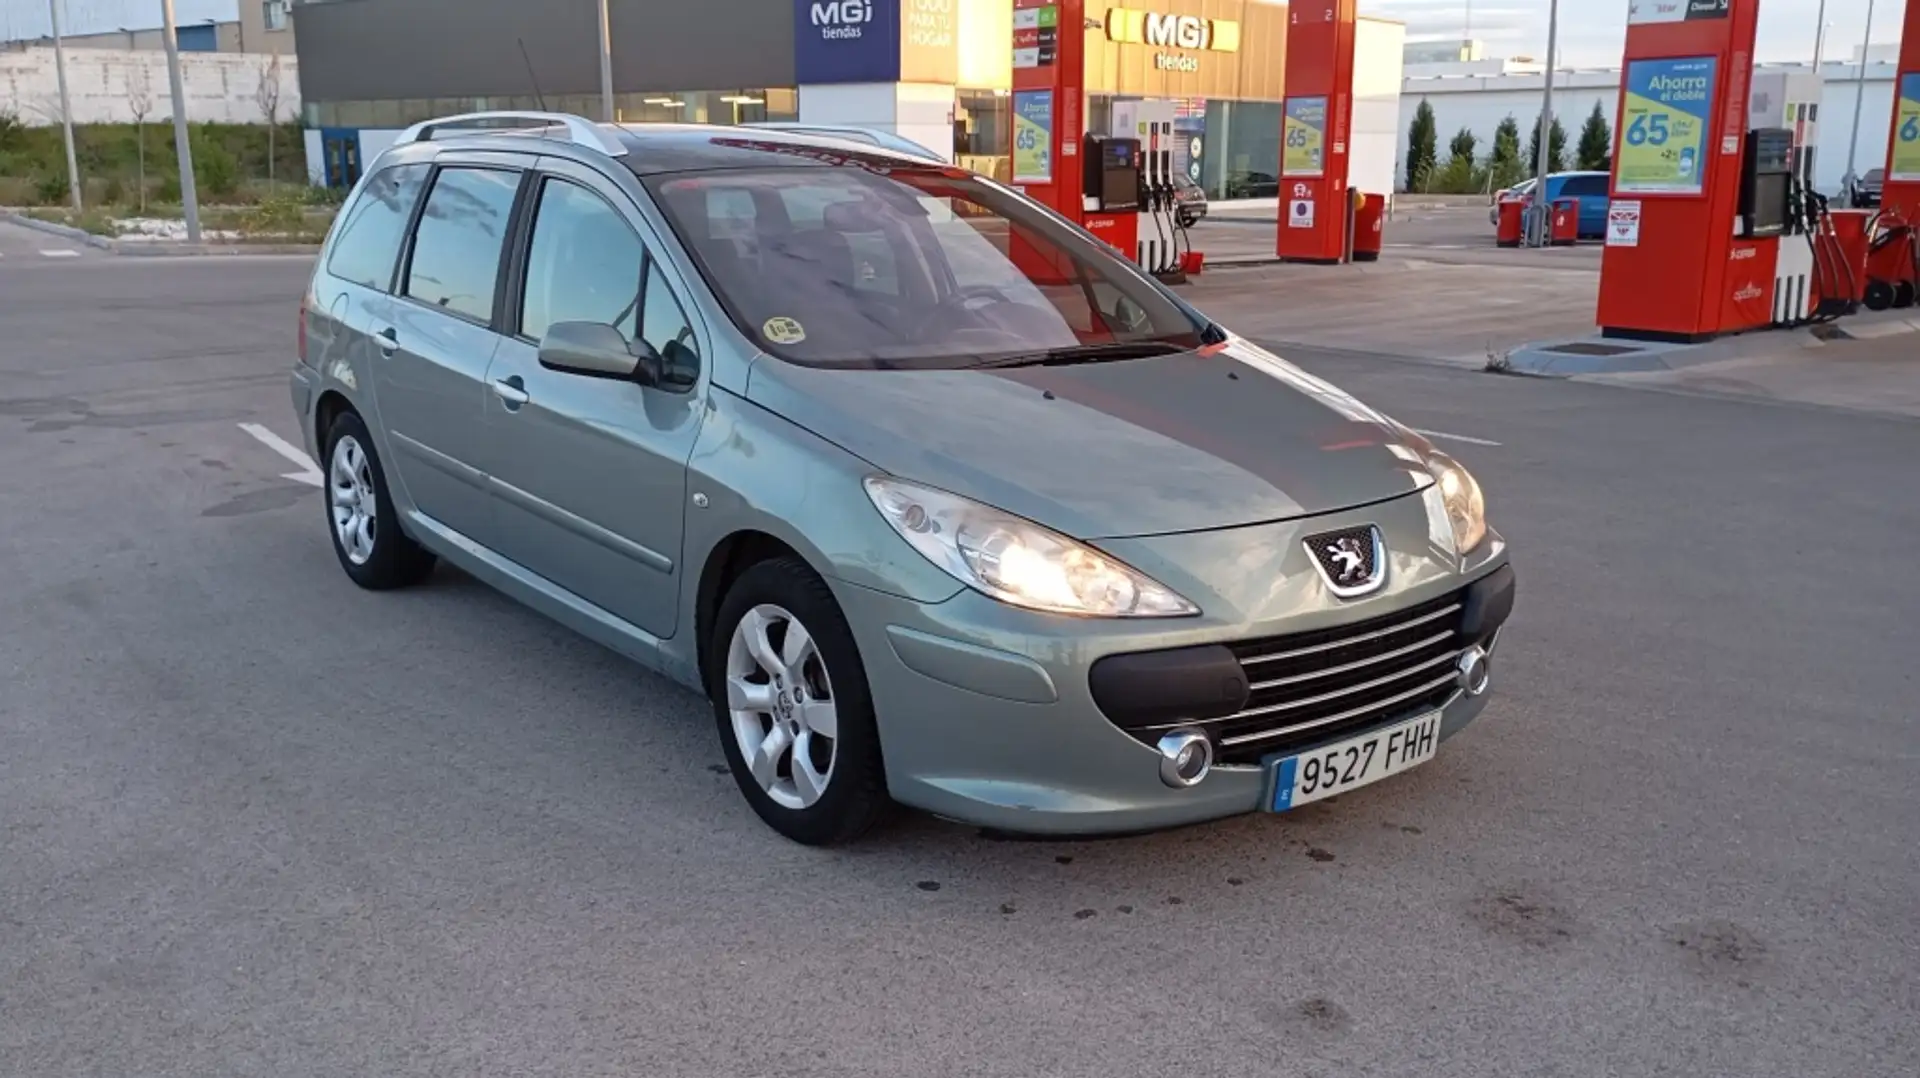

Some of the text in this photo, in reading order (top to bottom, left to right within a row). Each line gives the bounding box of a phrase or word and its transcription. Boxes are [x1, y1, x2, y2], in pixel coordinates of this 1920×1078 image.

[1292, 9, 1333, 24] 1 2
[822, 25, 862, 39] tiendas
[909, 29, 952, 46] HOGAR
[1155, 51, 1198, 71] tiendas
[1648, 74, 1706, 91] Ahorra
[1660, 90, 1706, 101] el doble
[1286, 128, 1307, 147] 65
[1626, 113, 1669, 146] 65
[1900, 116, 1920, 142] 6
[1016, 128, 1035, 150] 65
[1302, 719, 1435, 795] 9527 FHH
